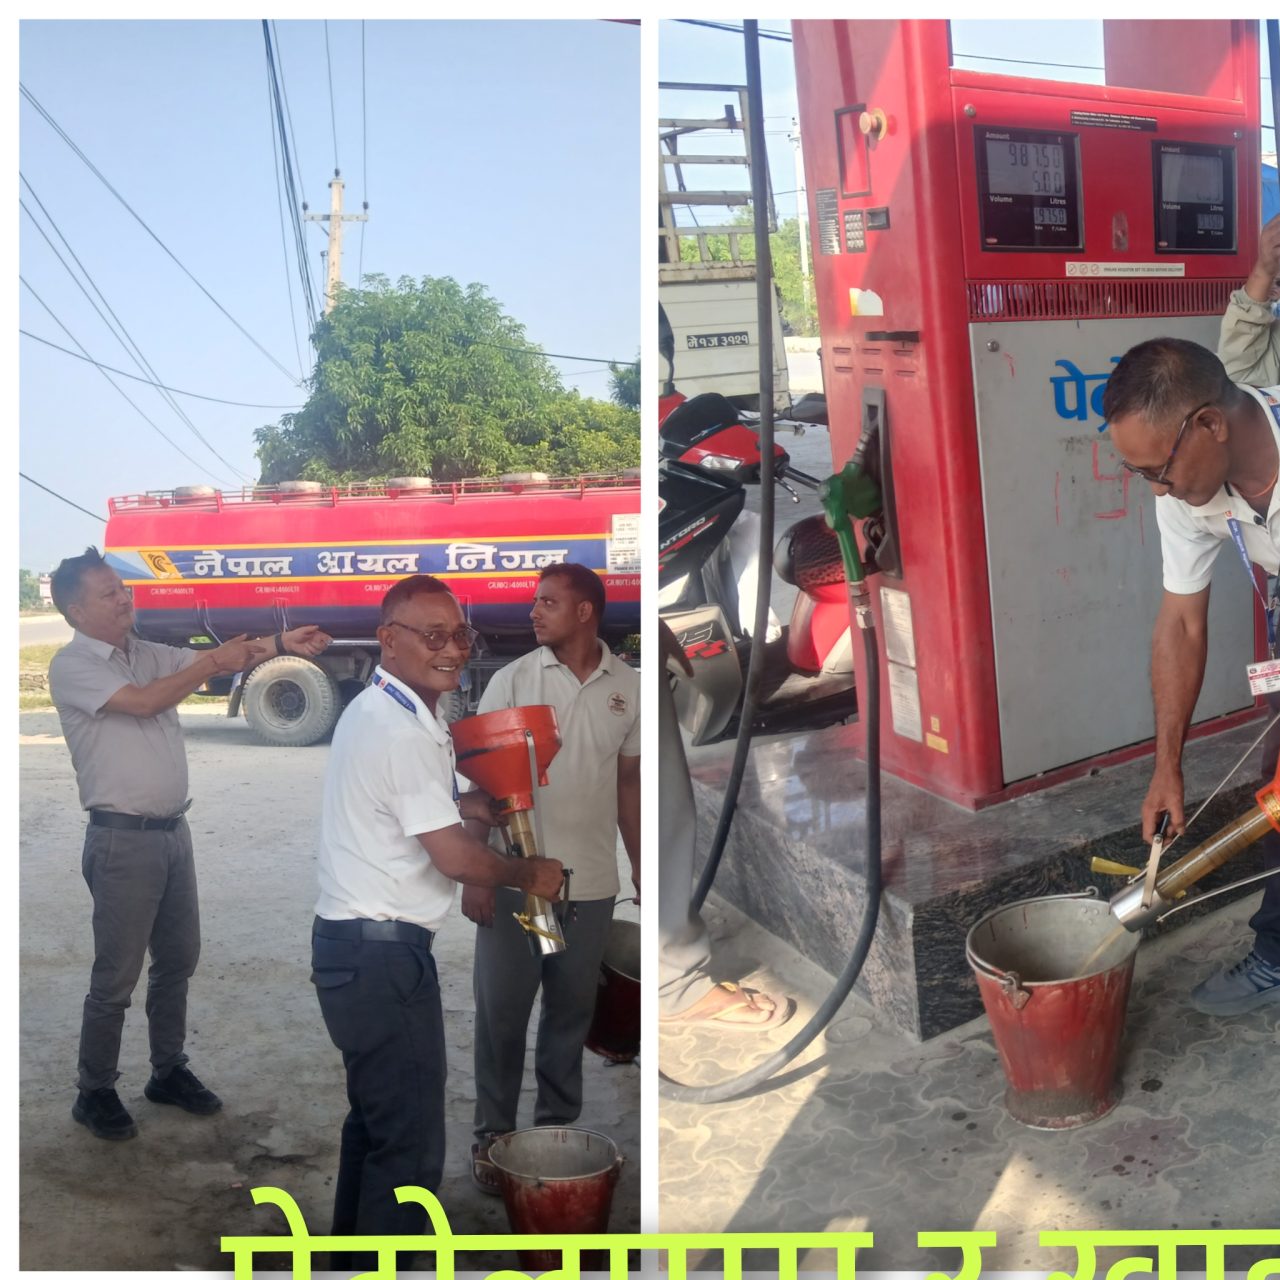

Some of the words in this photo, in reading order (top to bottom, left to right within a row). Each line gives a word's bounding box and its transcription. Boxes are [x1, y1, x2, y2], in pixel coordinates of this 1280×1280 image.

[985, 131, 1010, 140] Amount
[989, 195, 1013, 203] Volume
[1049, 197, 1067, 205] Litres
[193, 549, 293, 577] नेपाल
[317, 551, 420, 575] आयल
